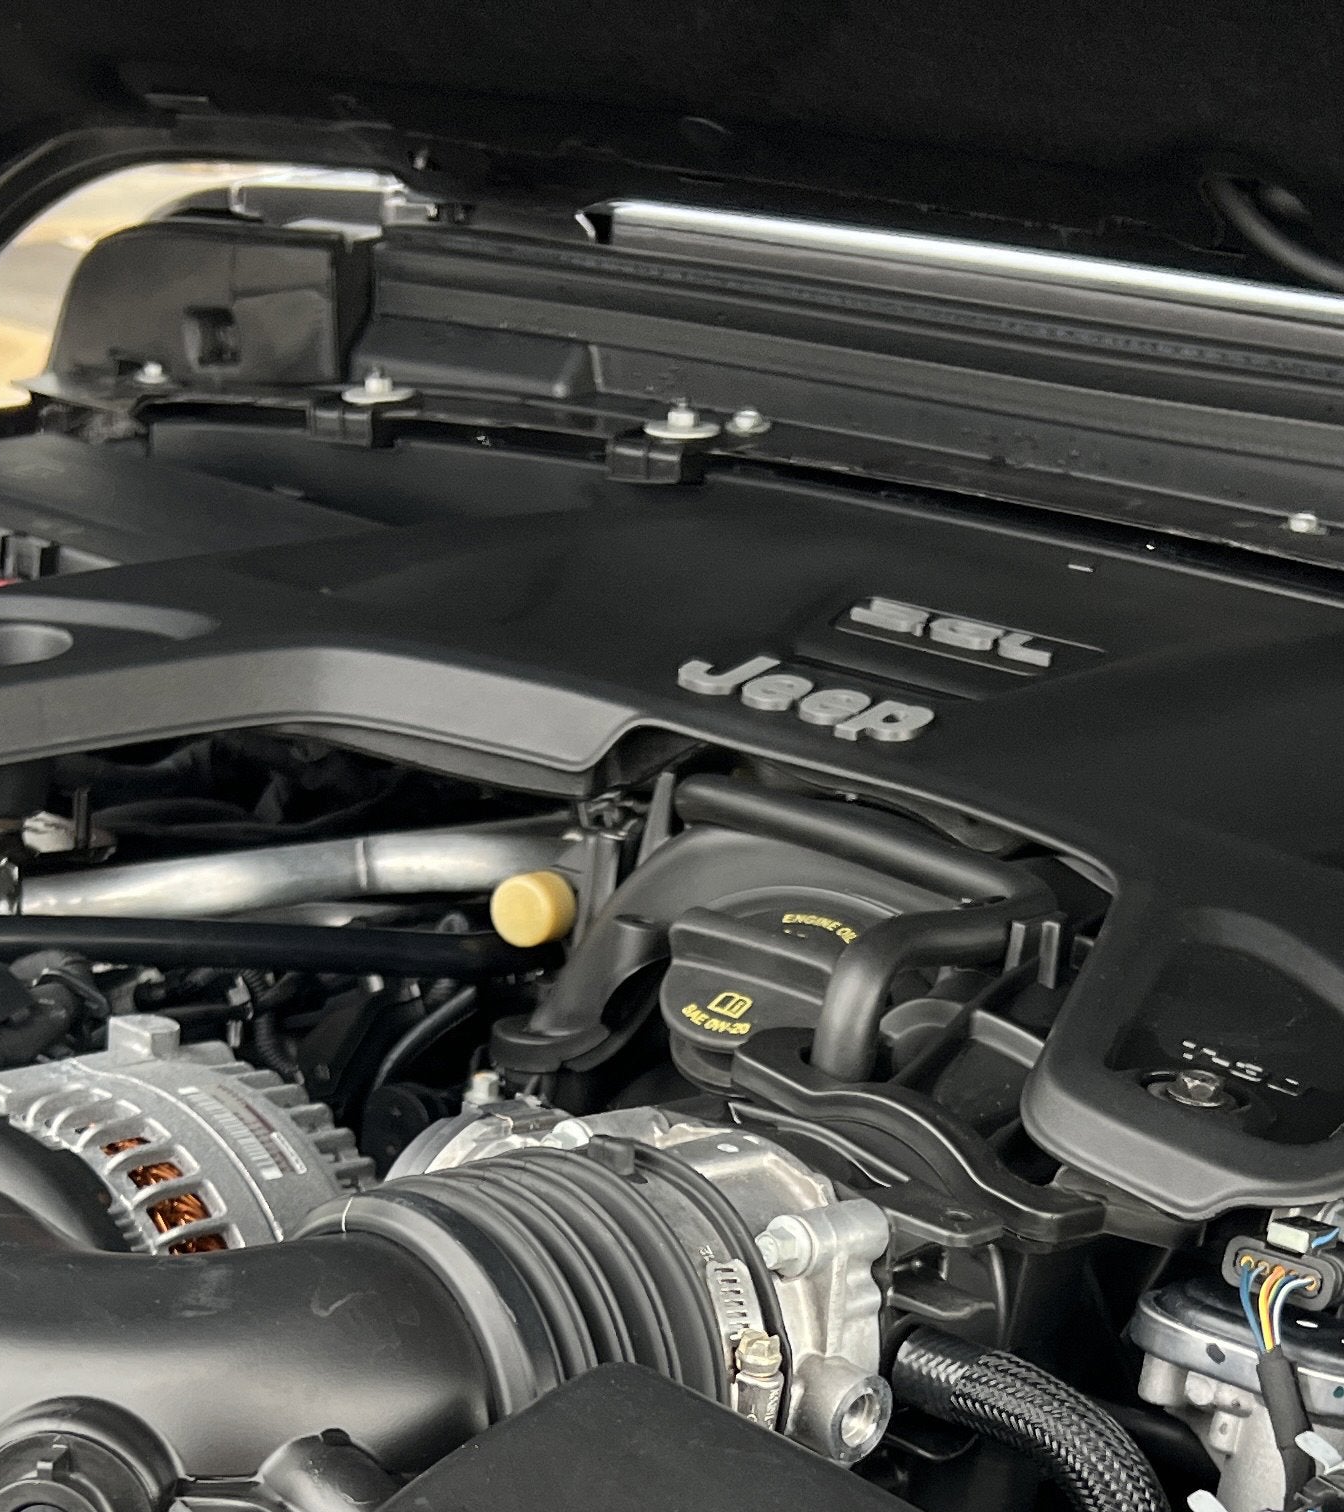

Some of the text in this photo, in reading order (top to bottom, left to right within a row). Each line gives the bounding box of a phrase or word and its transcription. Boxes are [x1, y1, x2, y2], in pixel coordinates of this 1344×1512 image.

[849, 596, 1053, 668] 3.6L
[676, 655, 936, 743] Jeep
[782, 913, 843, 932] ENGINE
[681, 1003, 710, 1026] SAE
